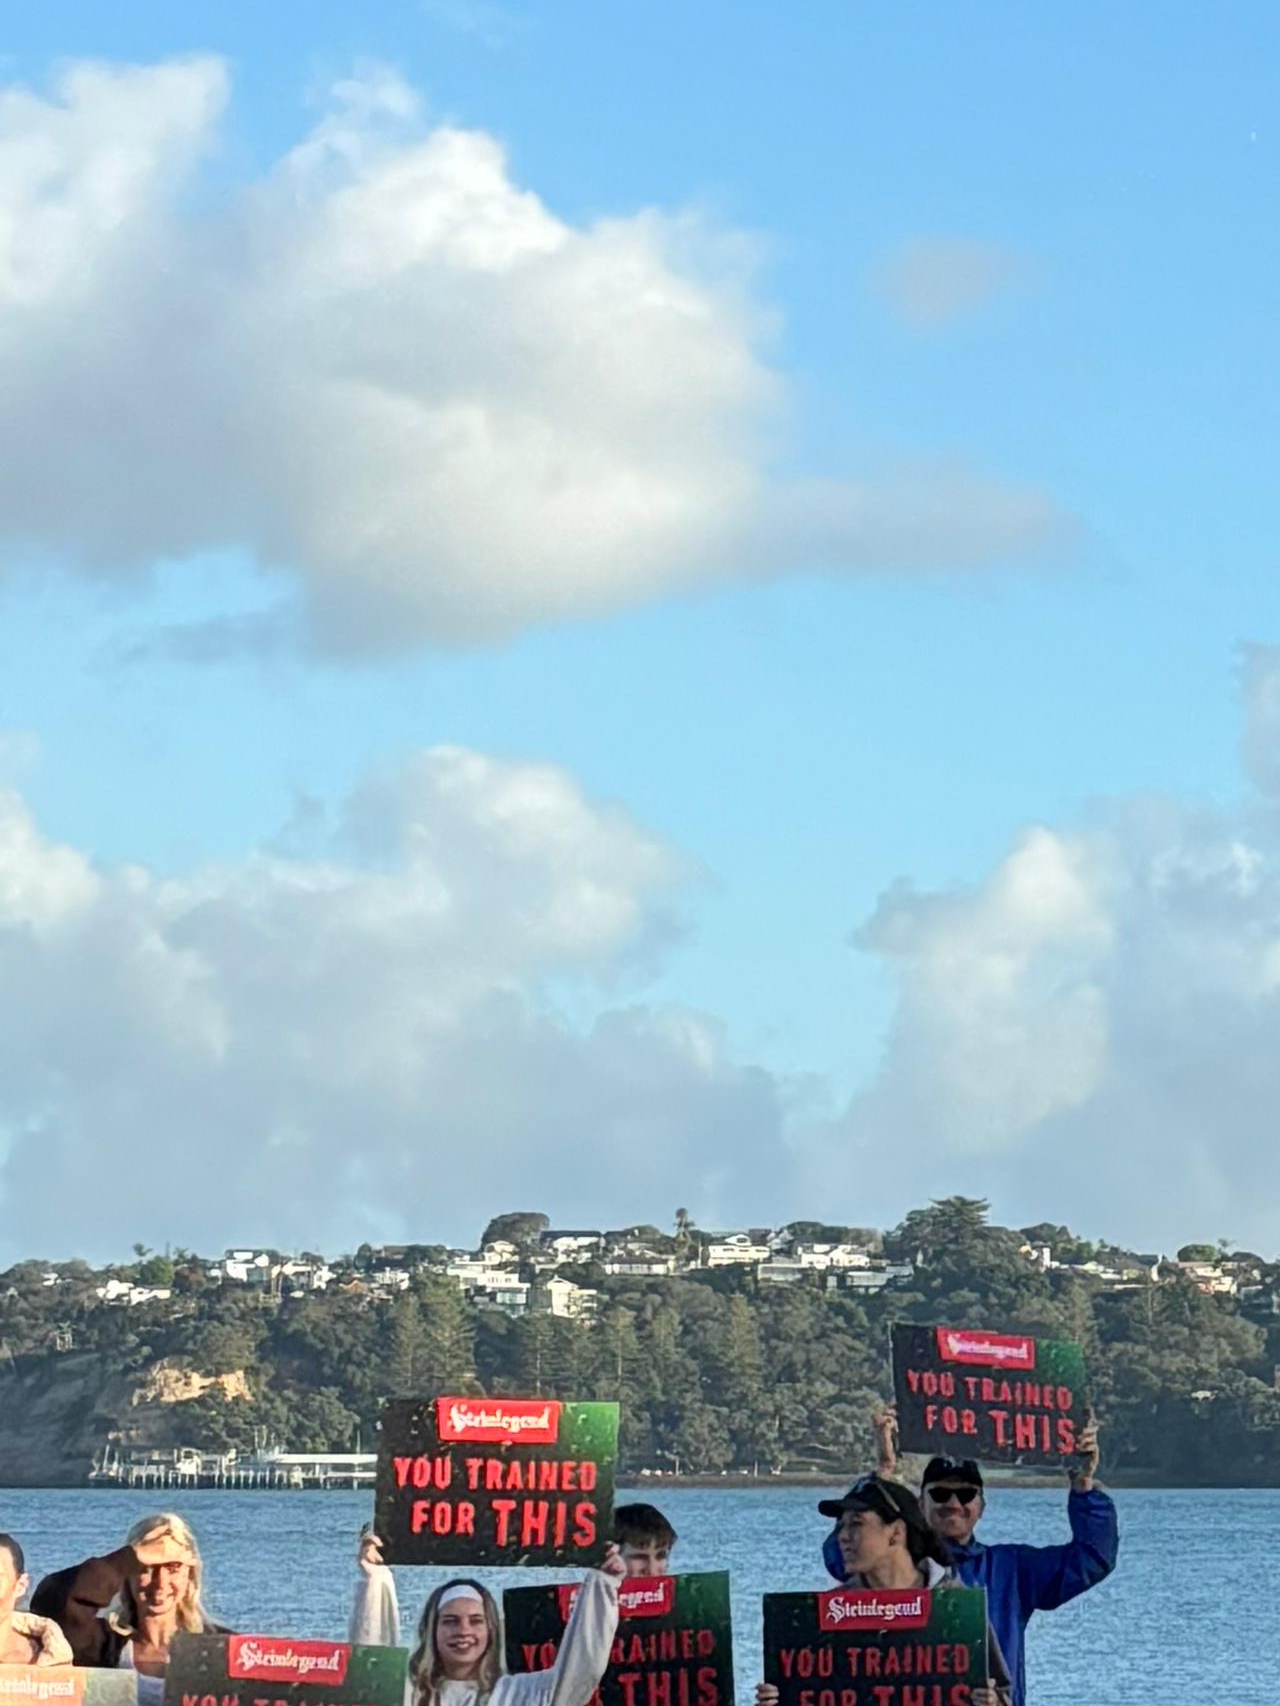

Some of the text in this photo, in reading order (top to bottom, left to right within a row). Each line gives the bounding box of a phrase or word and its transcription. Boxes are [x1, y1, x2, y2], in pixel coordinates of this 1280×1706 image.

[906, 1369, 1073, 1411] YOU TRAINED
[925, 1405, 1077, 1455] FOR THIS
[393, 1456, 597, 1490] YOU TRAINED
[411, 1499, 597, 1547] FOR THIS
[826, 1597, 921, 1623] Steinlegend
[610, 1629, 716, 1664] RAINED
[779, 1644, 970, 1678] YOU TRAINED
